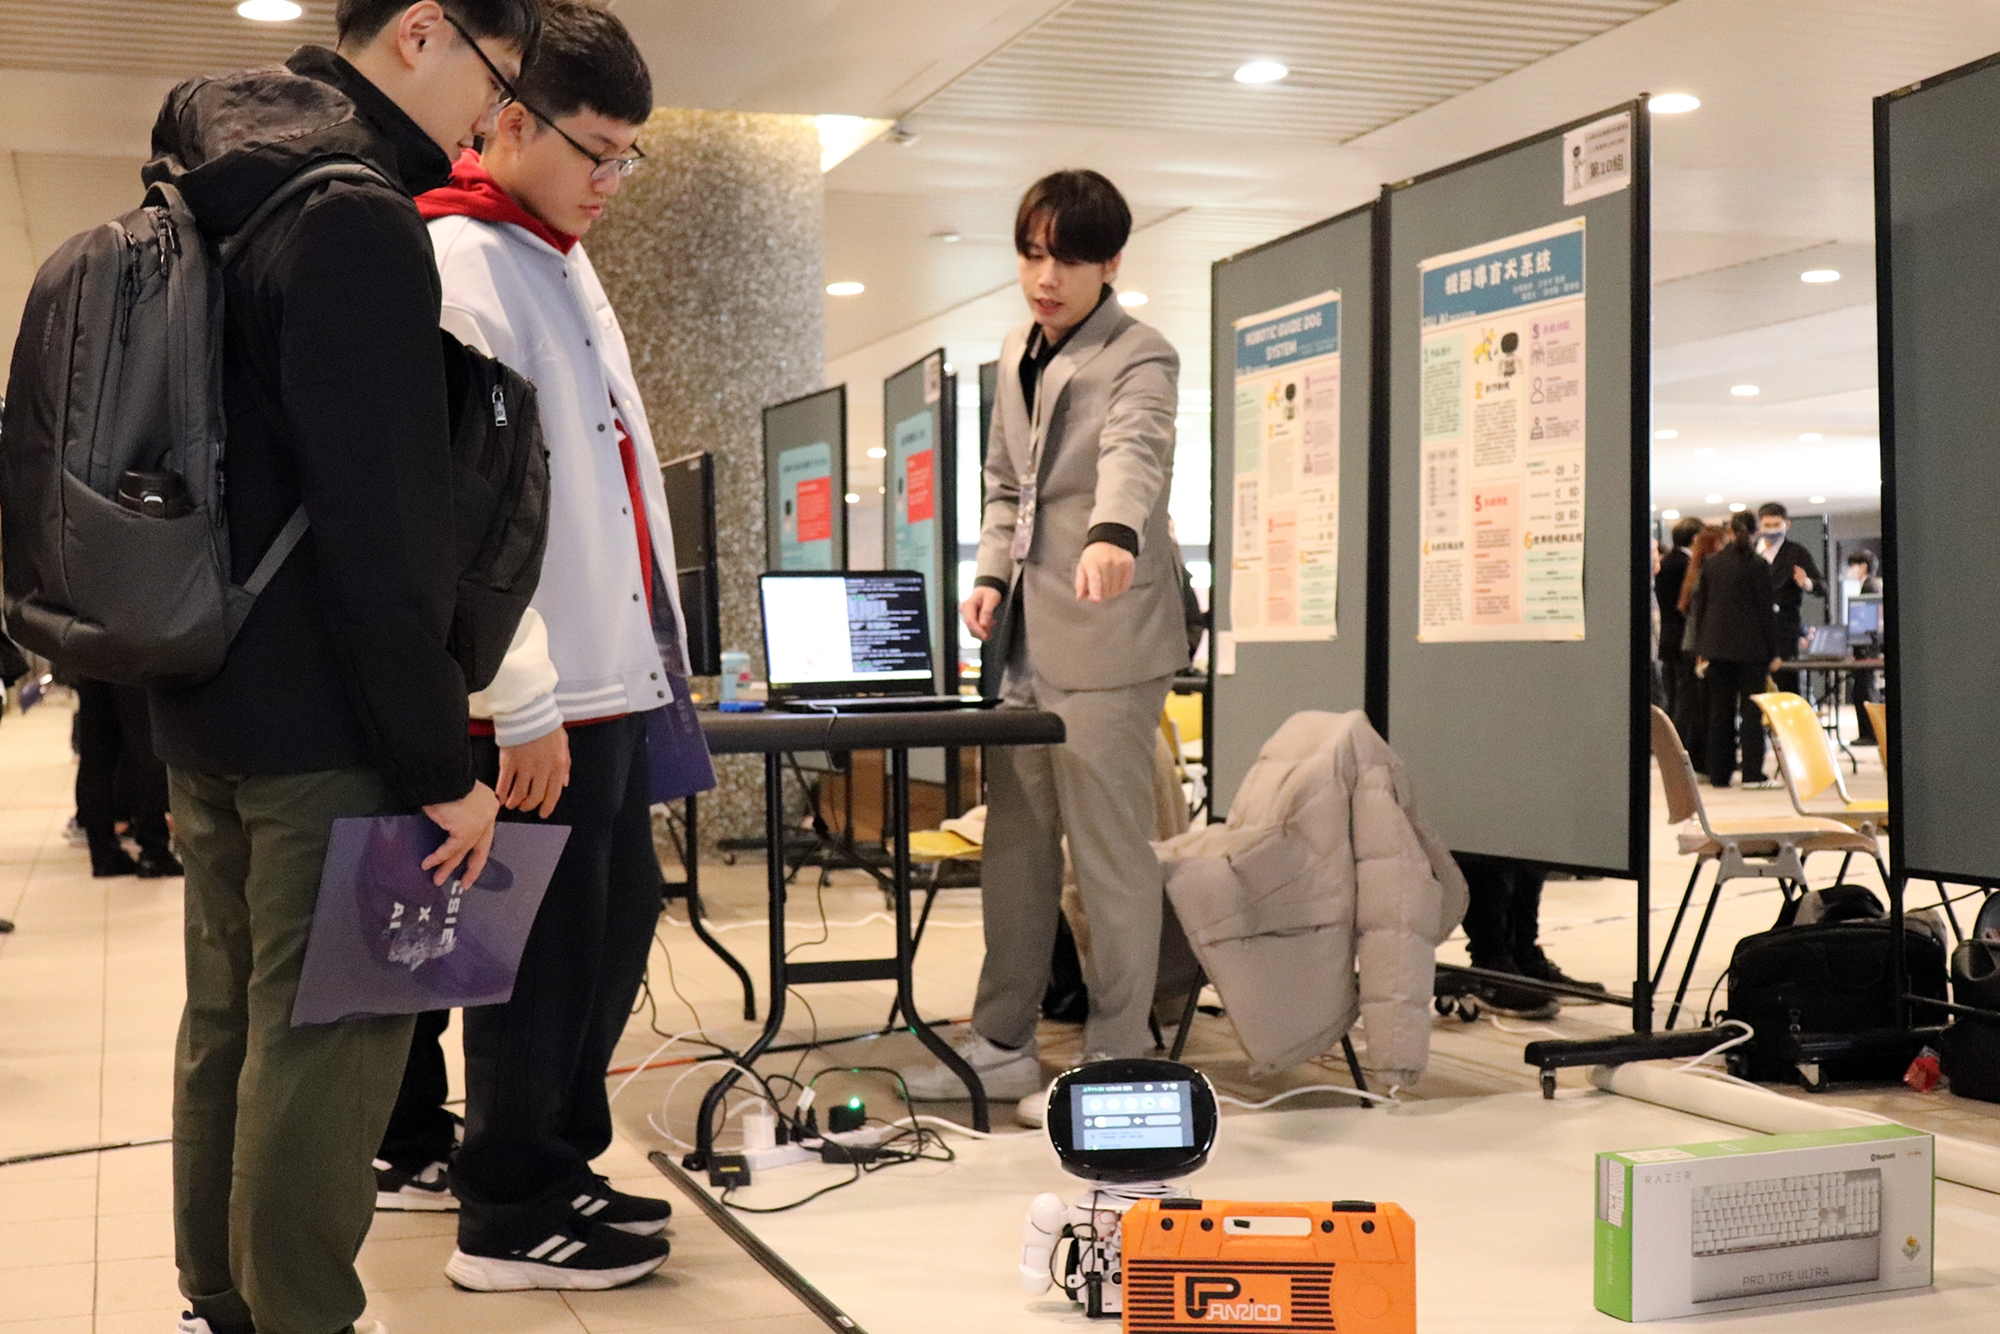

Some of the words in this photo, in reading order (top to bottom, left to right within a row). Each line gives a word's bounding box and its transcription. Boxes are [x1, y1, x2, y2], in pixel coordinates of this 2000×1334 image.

[1590, 153, 1624, 179] 第10組
[1304, 311, 1323, 330] DOG
[1265, 339, 1297, 361] SYSTEM
[1644, 1171, 1692, 1185] RAZER
[1742, 1273, 1764, 1287] PRO
[1768, 1270, 1795, 1283] TYPE
[1797, 1267, 1830, 1280] ULTRA
